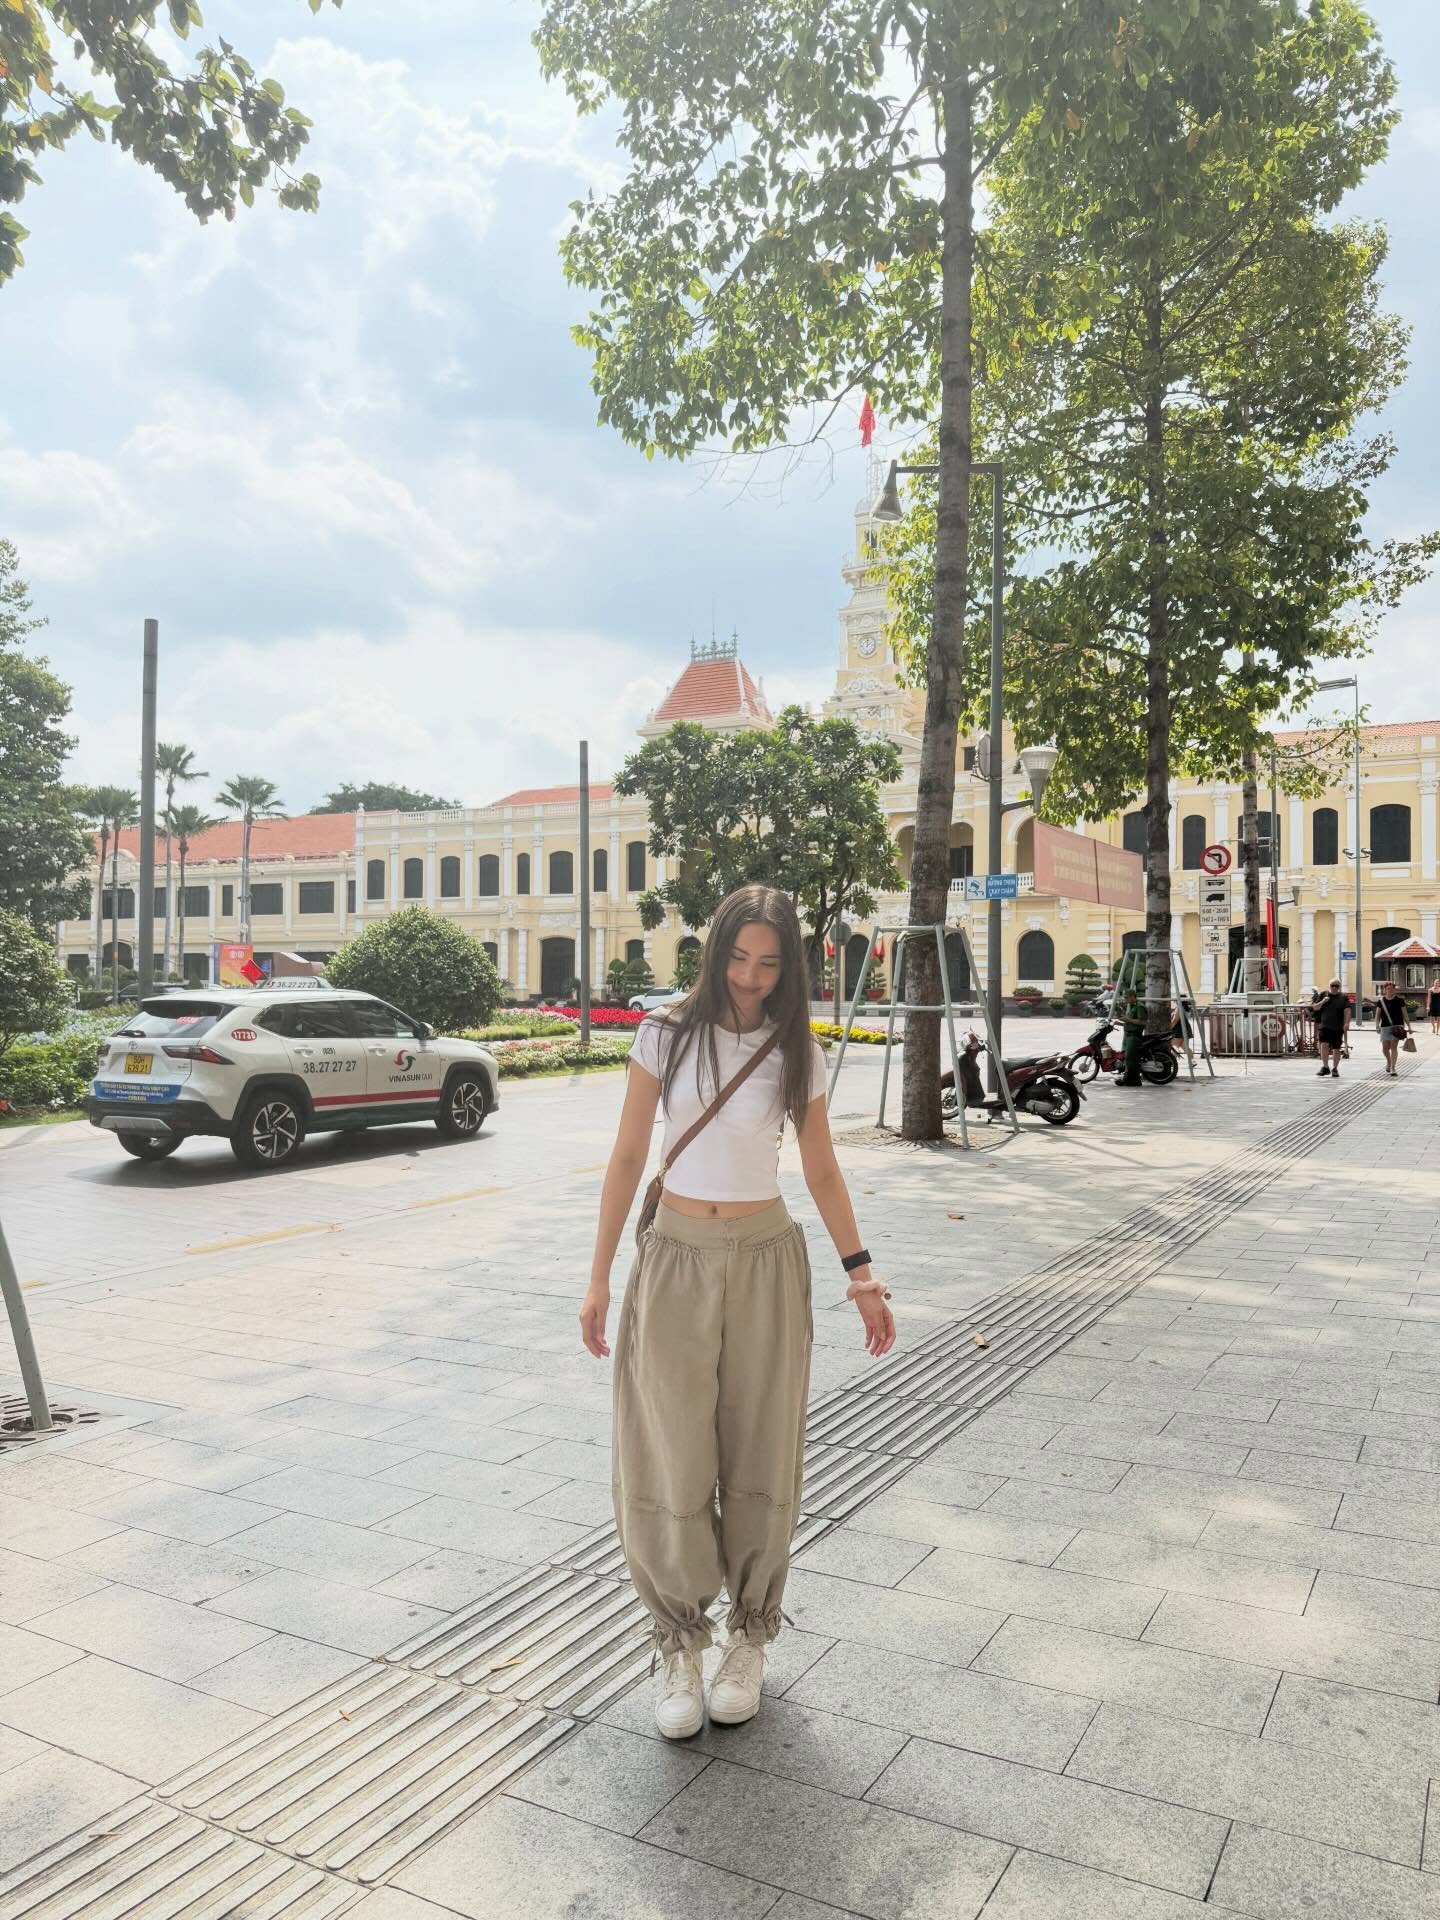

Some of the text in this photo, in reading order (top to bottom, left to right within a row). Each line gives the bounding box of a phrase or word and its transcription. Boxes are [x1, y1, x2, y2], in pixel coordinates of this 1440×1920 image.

[303, 1061, 357, 1073] 38.27 27 27
[389, 1074, 421, 1083] VINASUN
